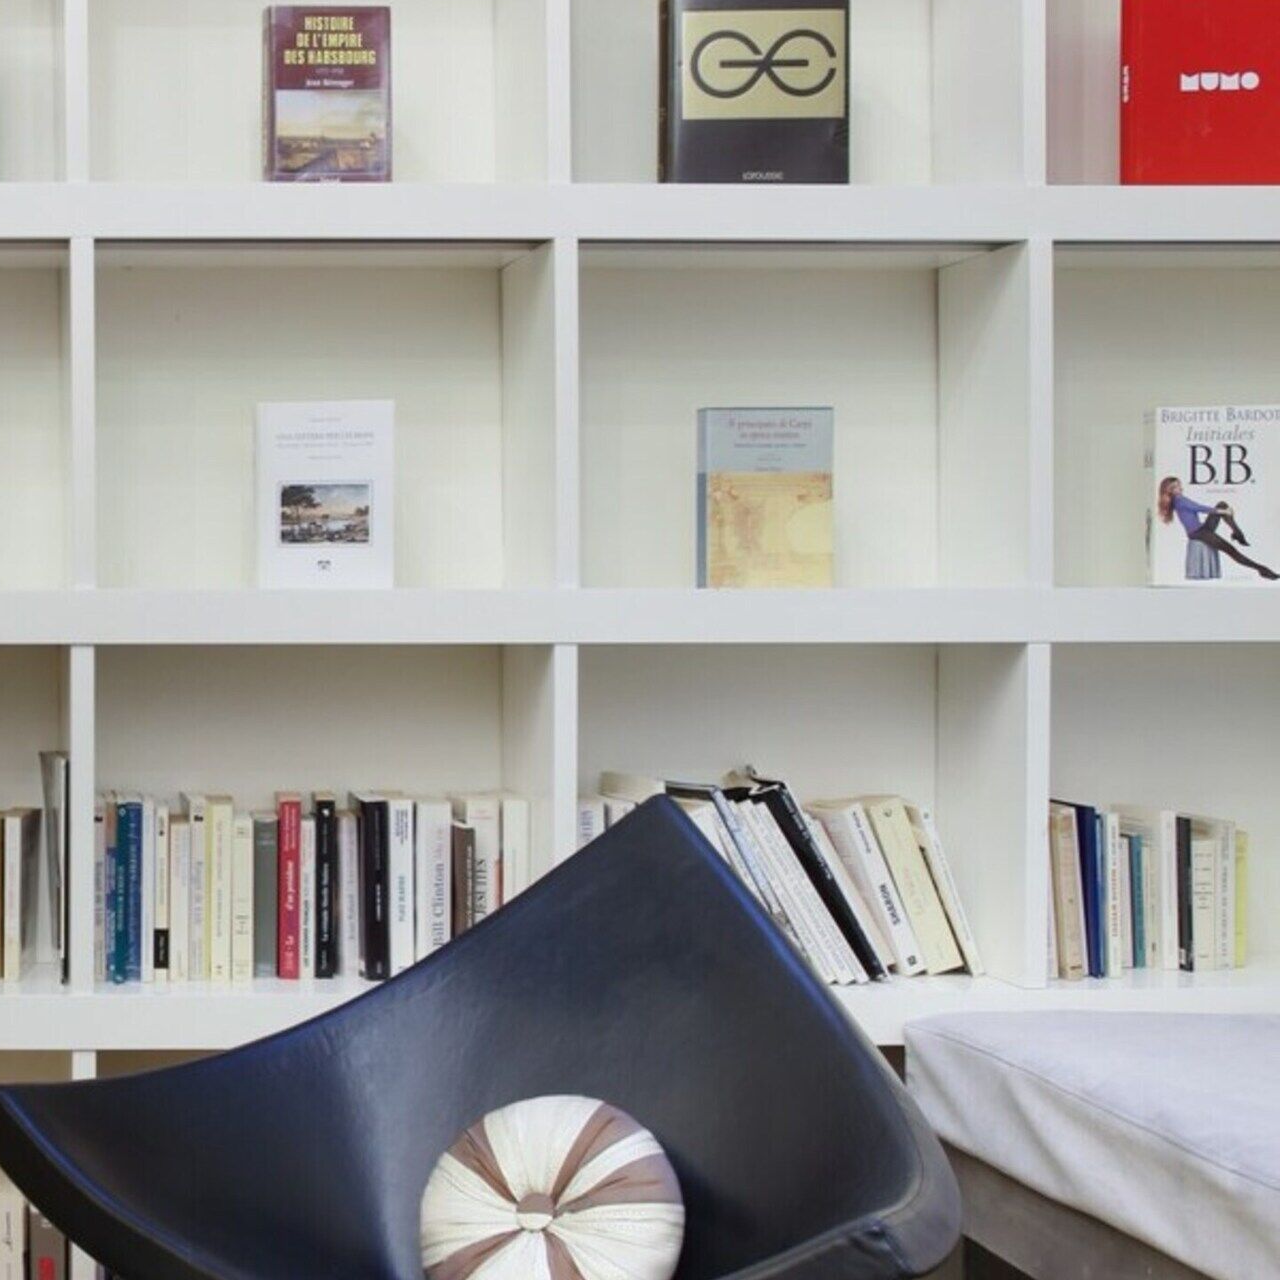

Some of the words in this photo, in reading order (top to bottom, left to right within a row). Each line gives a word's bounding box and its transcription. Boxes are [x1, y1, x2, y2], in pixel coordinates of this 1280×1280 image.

[305, 16, 354, 30] HISTOIRE
[297, 33, 310, 47] DE
[284, 51, 305, 64] DES
[1161, 409, 1219, 423] BRIGITTE
[431, 862, 446, 919] Clinton
[431, 921, 446, 947] Bill
